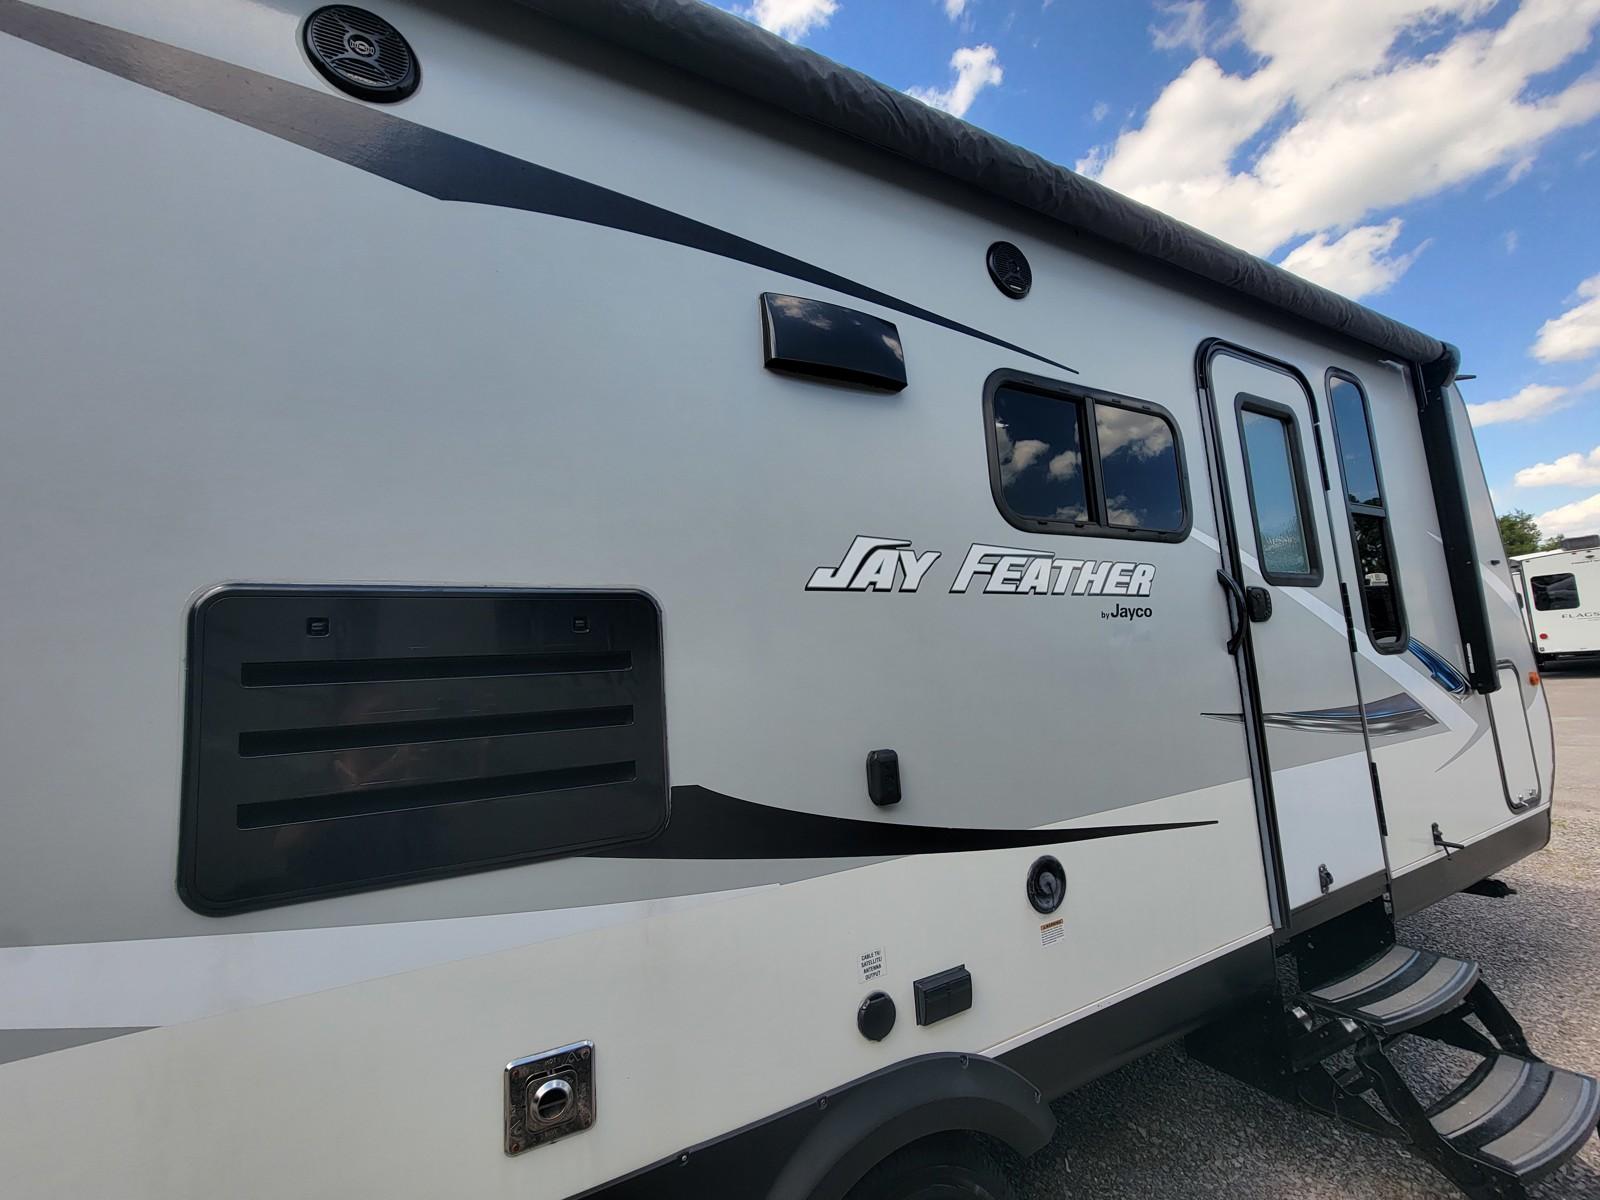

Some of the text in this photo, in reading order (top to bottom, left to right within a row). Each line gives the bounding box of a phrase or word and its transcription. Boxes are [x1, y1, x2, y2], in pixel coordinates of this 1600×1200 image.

[805, 535, 1156, 597] JAY FEATHER
[1101, 603, 1153, 621] by Jayco
